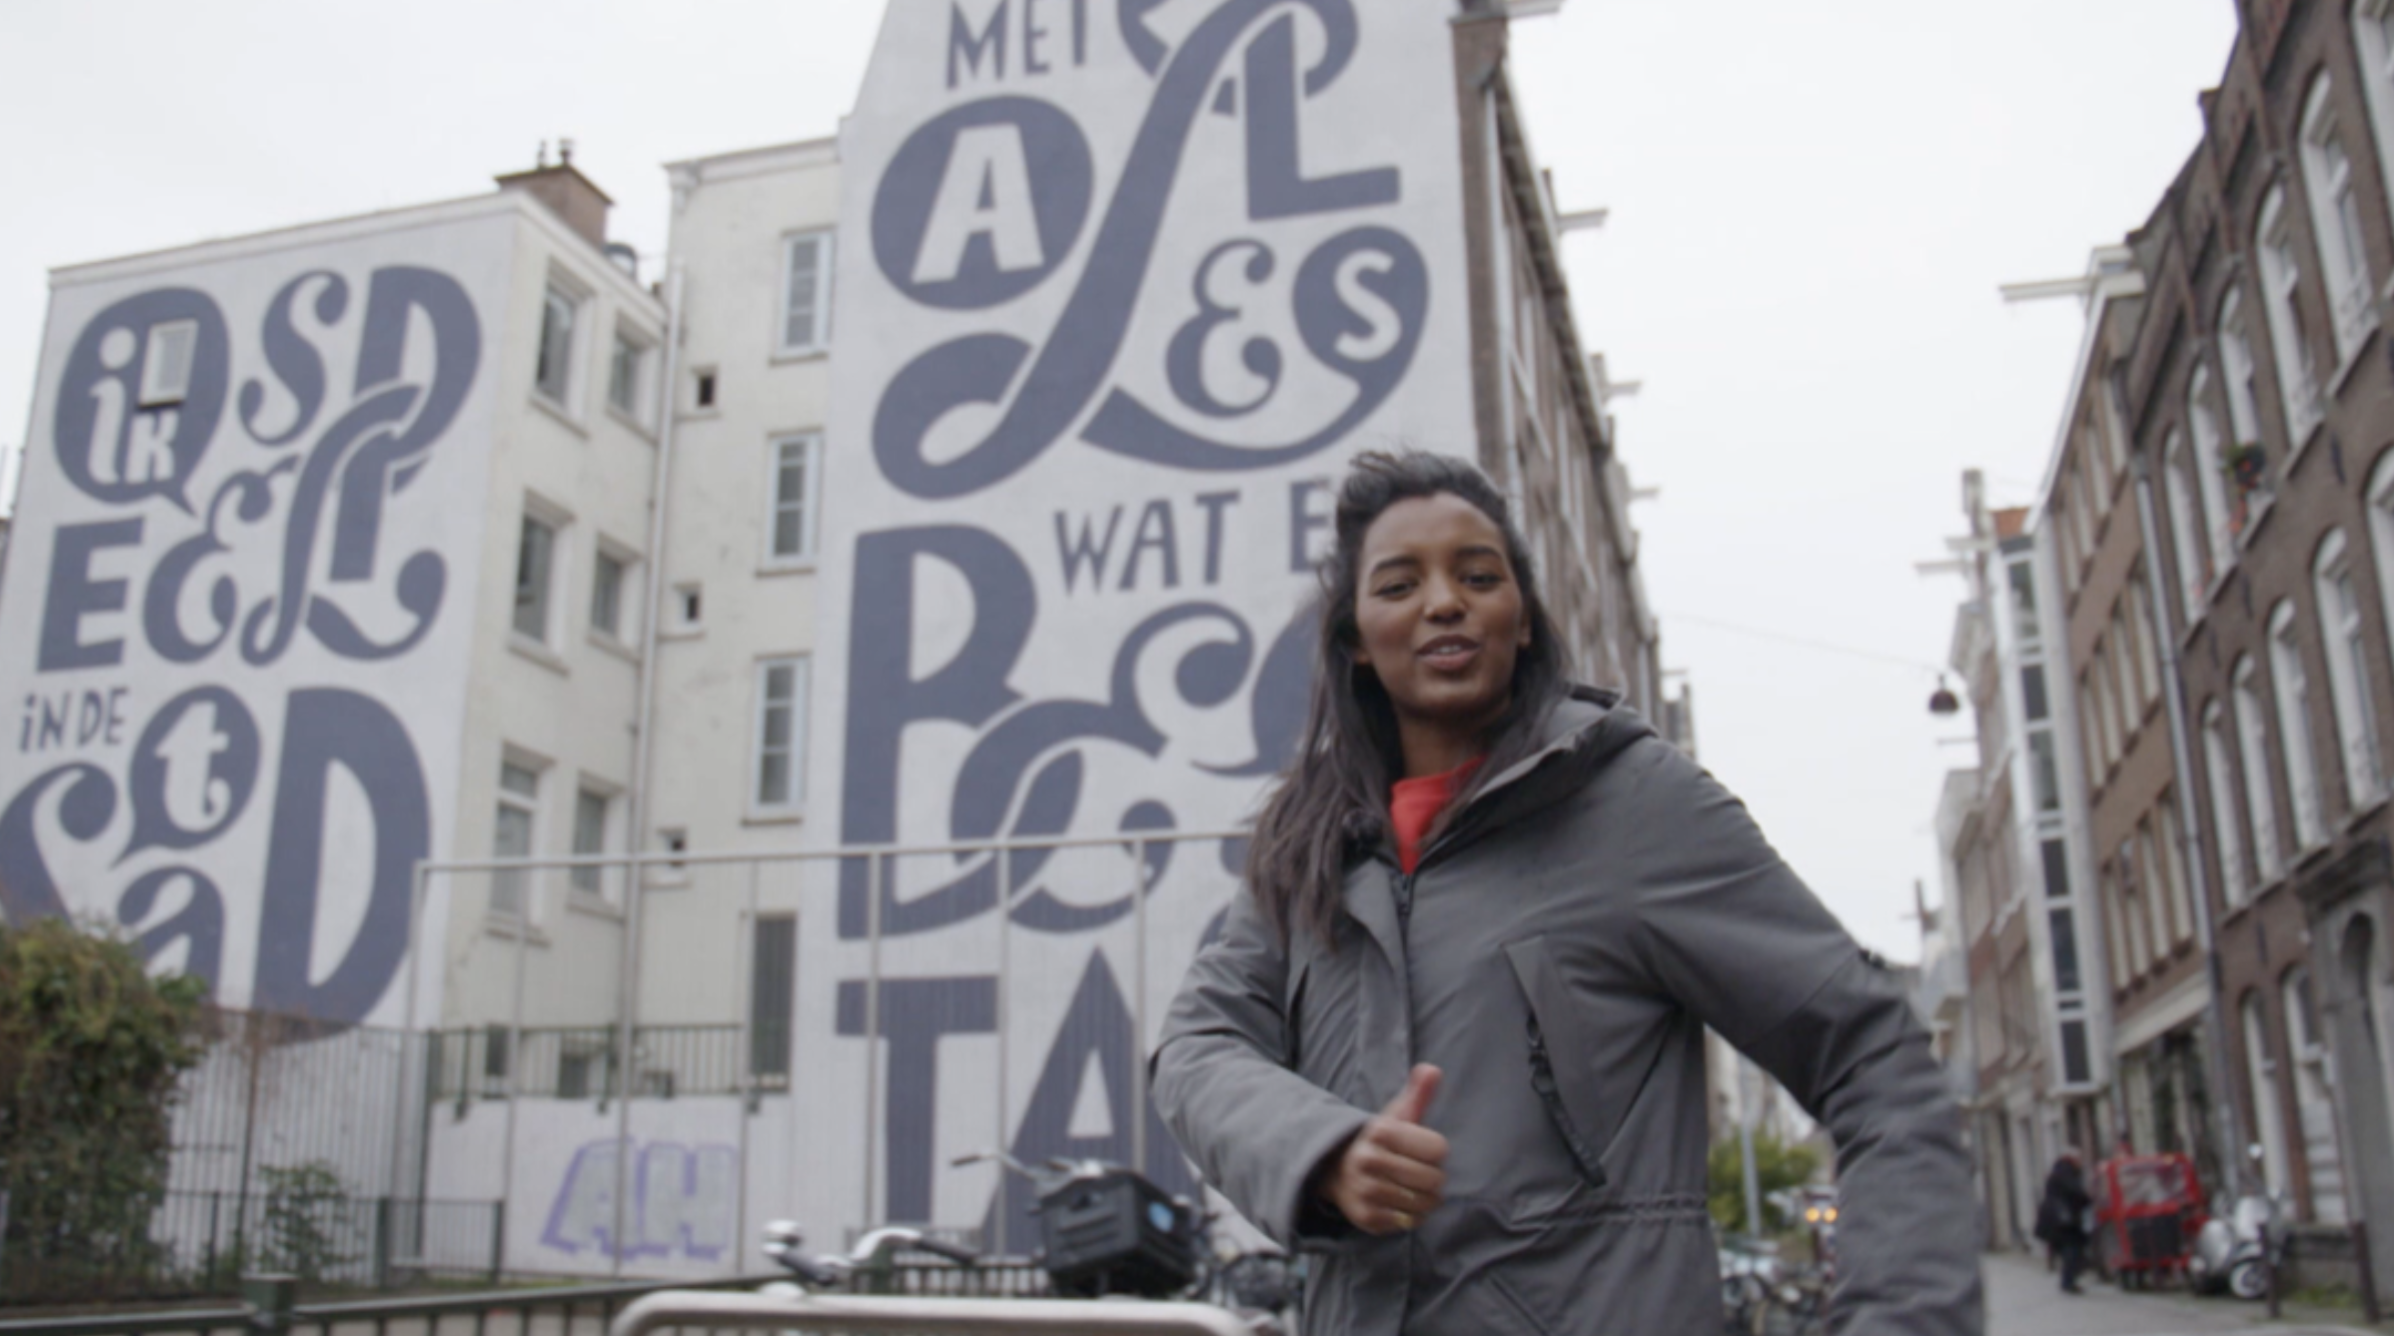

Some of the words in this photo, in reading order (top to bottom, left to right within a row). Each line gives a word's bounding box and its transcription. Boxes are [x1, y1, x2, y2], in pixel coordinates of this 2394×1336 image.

[1054, 490, 1241, 597] WAT
[1289, 477, 1332, 574] E
[78, 686, 130, 746] DE
